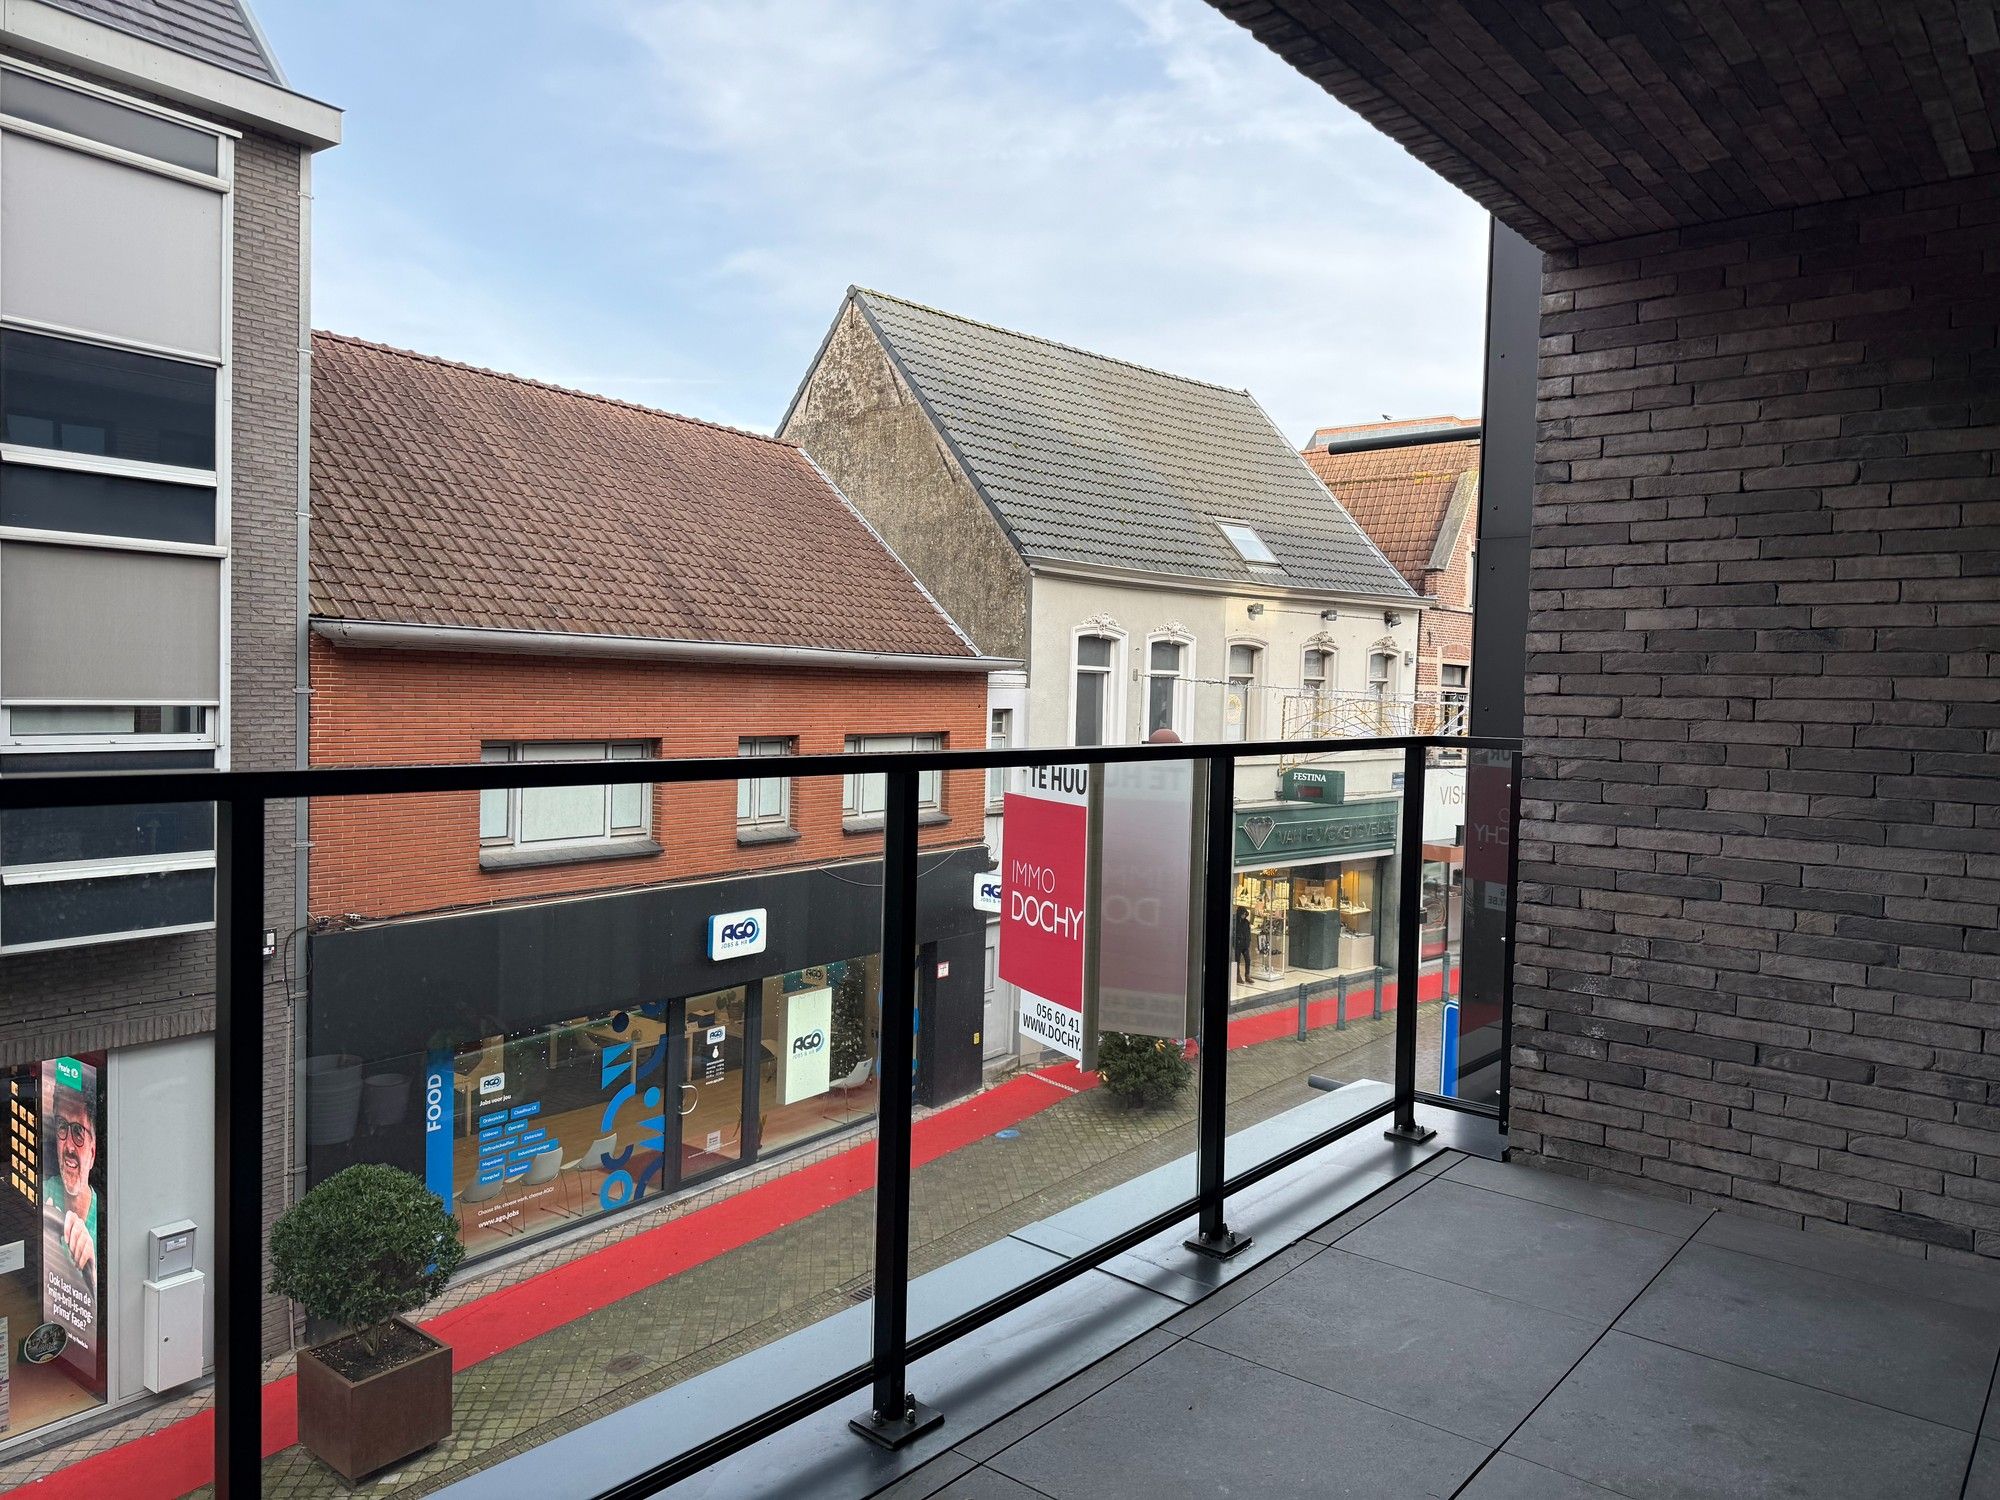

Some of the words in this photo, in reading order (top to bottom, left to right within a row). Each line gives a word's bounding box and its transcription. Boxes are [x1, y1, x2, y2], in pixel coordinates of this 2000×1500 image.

[1030, 765, 1047, 789] TE
[1293, 772, 1327, 782] FESTINA
[1279, 829, 1302, 844] VAN
[1012, 859, 1056, 893] IMMO
[1011, 890, 1083, 940] DOCHY
[722, 921, 756, 943] AGO
[1036, 1003, 1053, 1021] 056
[1055, 1011, 1066, 1027] 60
[1068, 1017, 1080, 1033] 41
[793, 1032, 822, 1054] AGO
[1023, 1013, 1081, 1052] WWW.DOCHY.
[484, 1078, 500, 1088] AGO
[427, 1074, 442, 1133] FOOD
[480, 1099, 491, 1107] Jobs
[478, 1207, 494, 1216] Choose
[478, 1209, 520, 1229] www.ago.jobs
[49, 1271, 60, 1287] Ook
[60, 1278, 72, 1295] last
[72, 1288, 83, 1302] van
[83, 1293, 92, 1307] de
[71, 1312, 87, 1332] fase?
